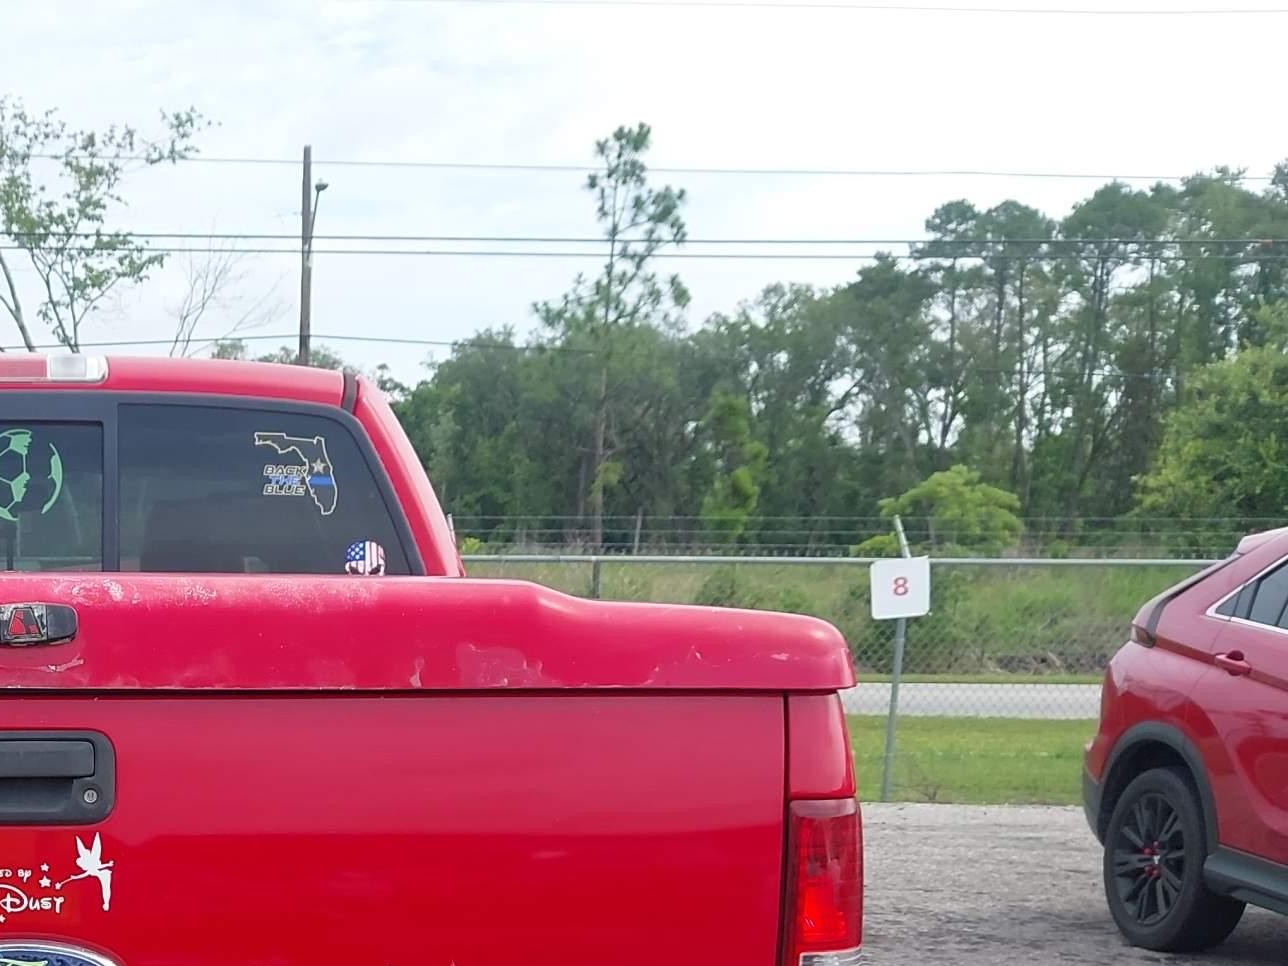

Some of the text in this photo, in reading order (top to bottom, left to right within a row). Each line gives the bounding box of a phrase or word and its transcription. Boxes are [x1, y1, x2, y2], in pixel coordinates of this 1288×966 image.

[269, 475, 301, 485] THE
[263, 484, 306, 495] BLUE
[893, 576, 909, 596] 8
